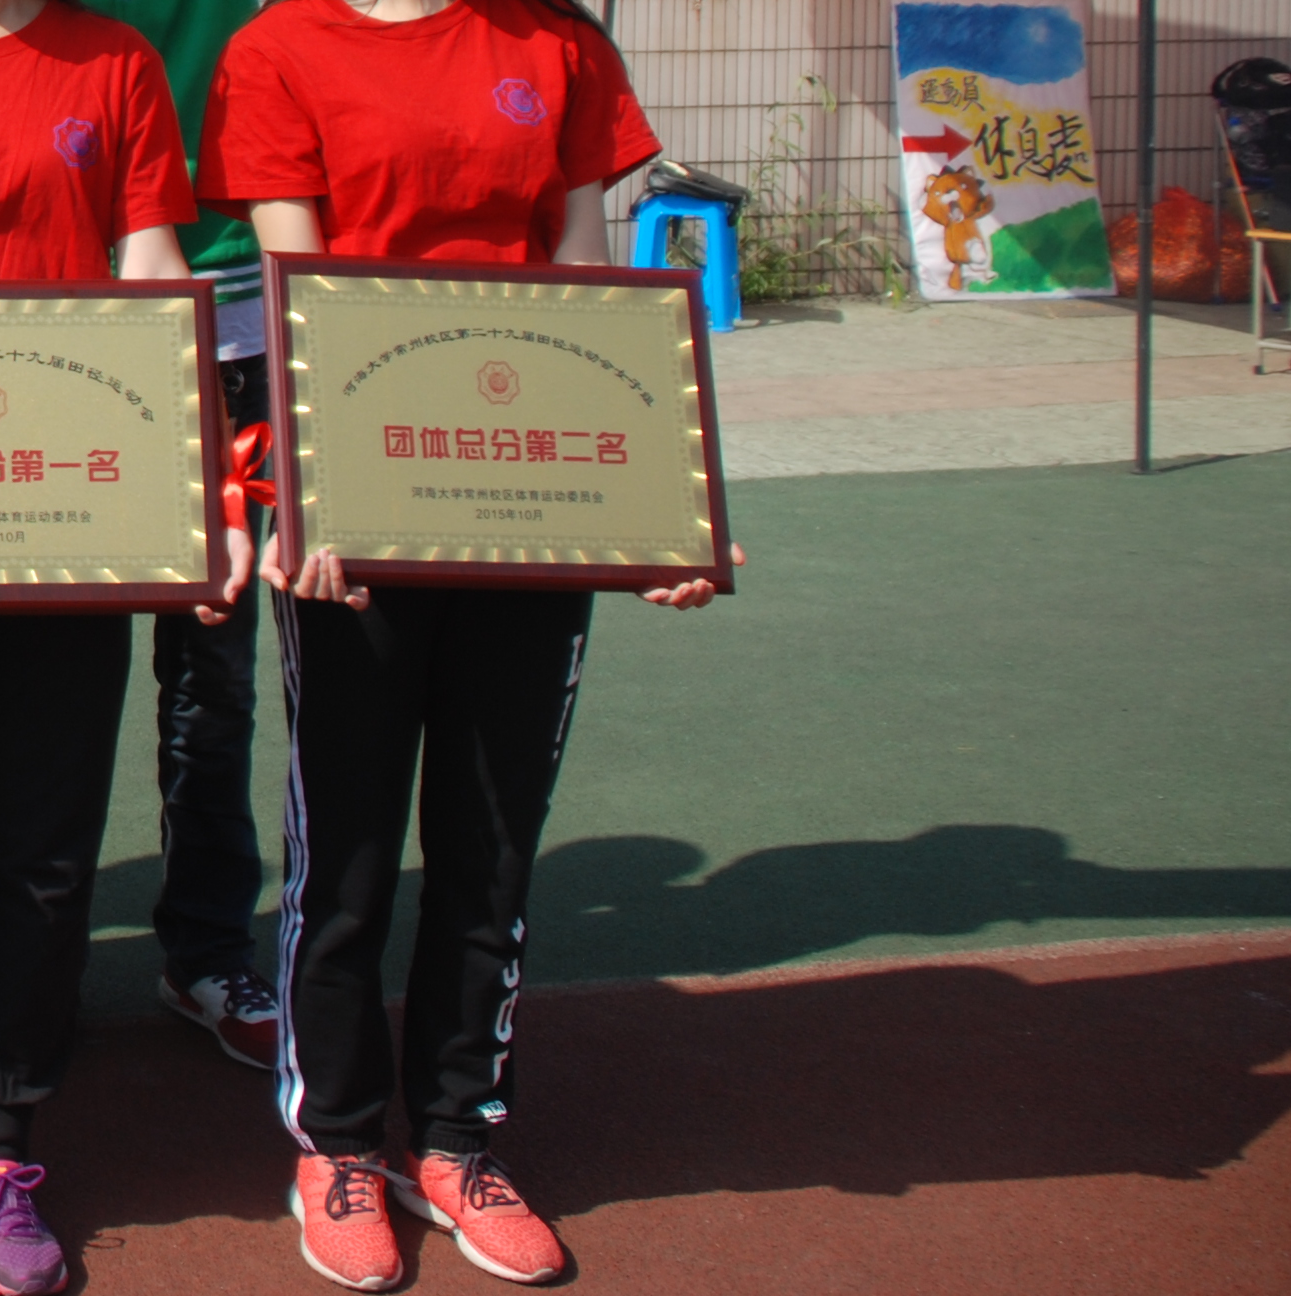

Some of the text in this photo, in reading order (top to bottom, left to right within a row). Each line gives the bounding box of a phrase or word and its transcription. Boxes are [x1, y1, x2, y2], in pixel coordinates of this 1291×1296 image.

[383, 425, 628, 465] 团体总分第二名
[411, 487, 604, 504] 河海大学常州校区体育运动委员会
[475, 508, 544, 523] 2015年10月
